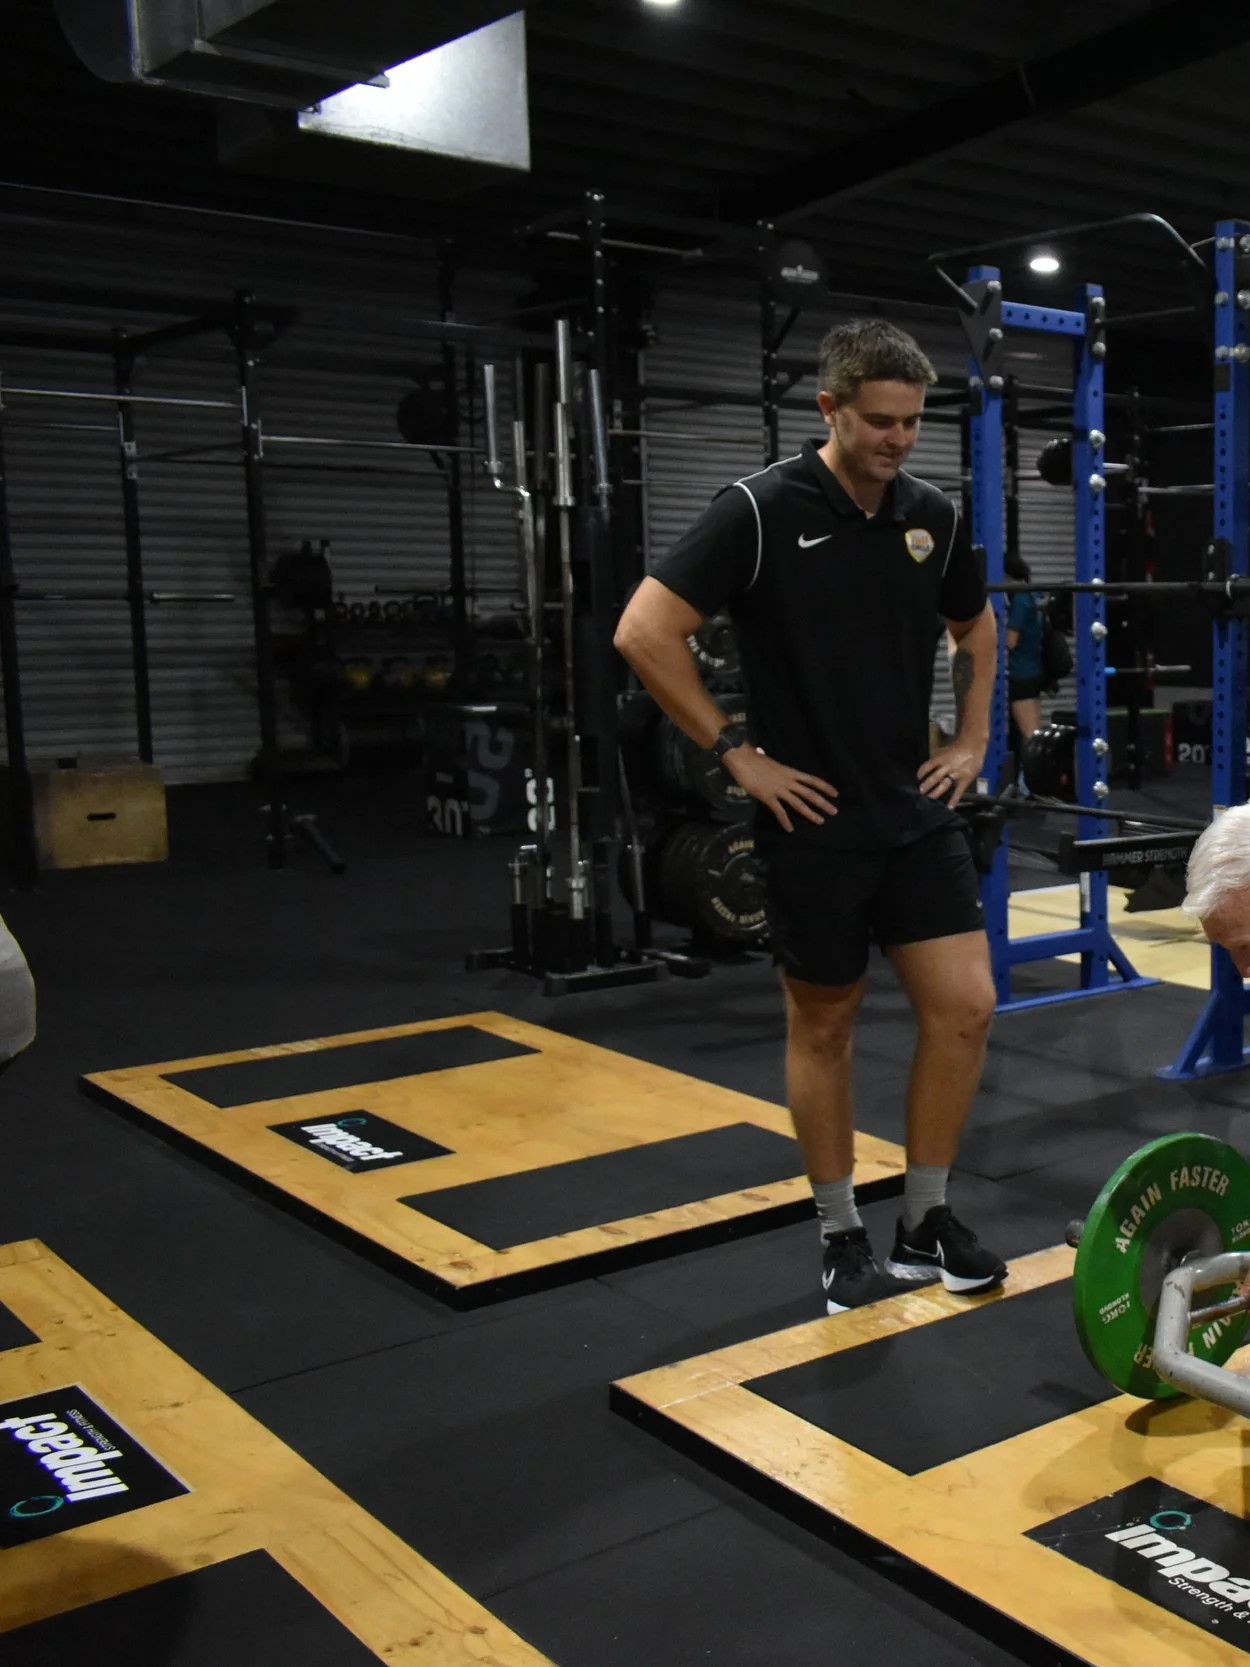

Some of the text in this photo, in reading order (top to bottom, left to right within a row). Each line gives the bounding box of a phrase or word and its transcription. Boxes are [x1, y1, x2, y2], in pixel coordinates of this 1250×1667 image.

[299, 1121, 404, 1162] impact
[1114, 1165, 1231, 1255] AGAIN FASTER
[0, 1411, 131, 1503] impact
[1167, 1575, 1235, 1615] Strength
[1232, 1609, 1250, 1623] &
